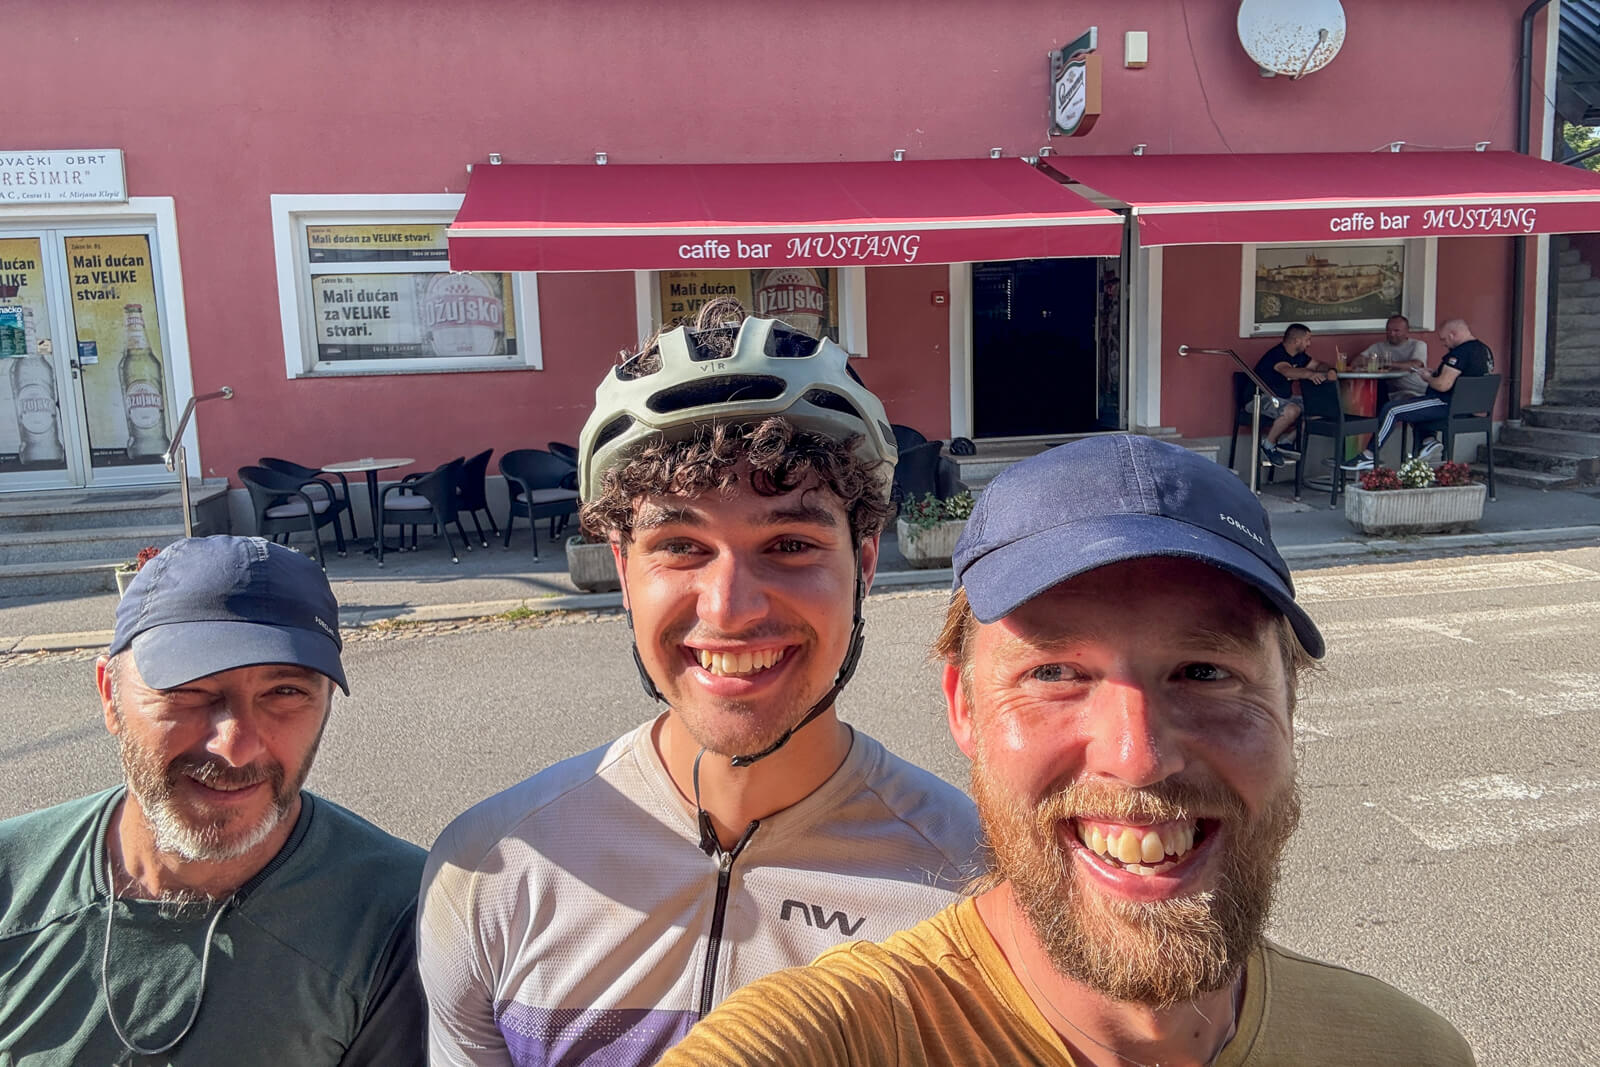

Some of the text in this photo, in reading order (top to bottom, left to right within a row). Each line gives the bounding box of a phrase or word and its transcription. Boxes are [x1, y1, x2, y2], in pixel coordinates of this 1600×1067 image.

[65, 155, 106, 165] OBRT
[1330, 207, 1537, 233] caffe bar MUSTANG
[312, 234, 331, 243] Mali
[372, 233, 403, 242] VELIKE
[404, 233, 433, 242] stvari.
[679, 234, 921, 263] caffe bar MUSTANG
[73, 253, 144, 268] Mali dućan
[74, 270, 137, 285] za VELIKE
[77, 287, 120, 300] stvari.
[323, 288, 399, 303] Mali dućan
[670, 282, 736, 296] Mali dućan
[324, 306, 391, 321] za VELIKE
[671, 302, 684, 312] za
[326, 323, 373, 337] stvari.
